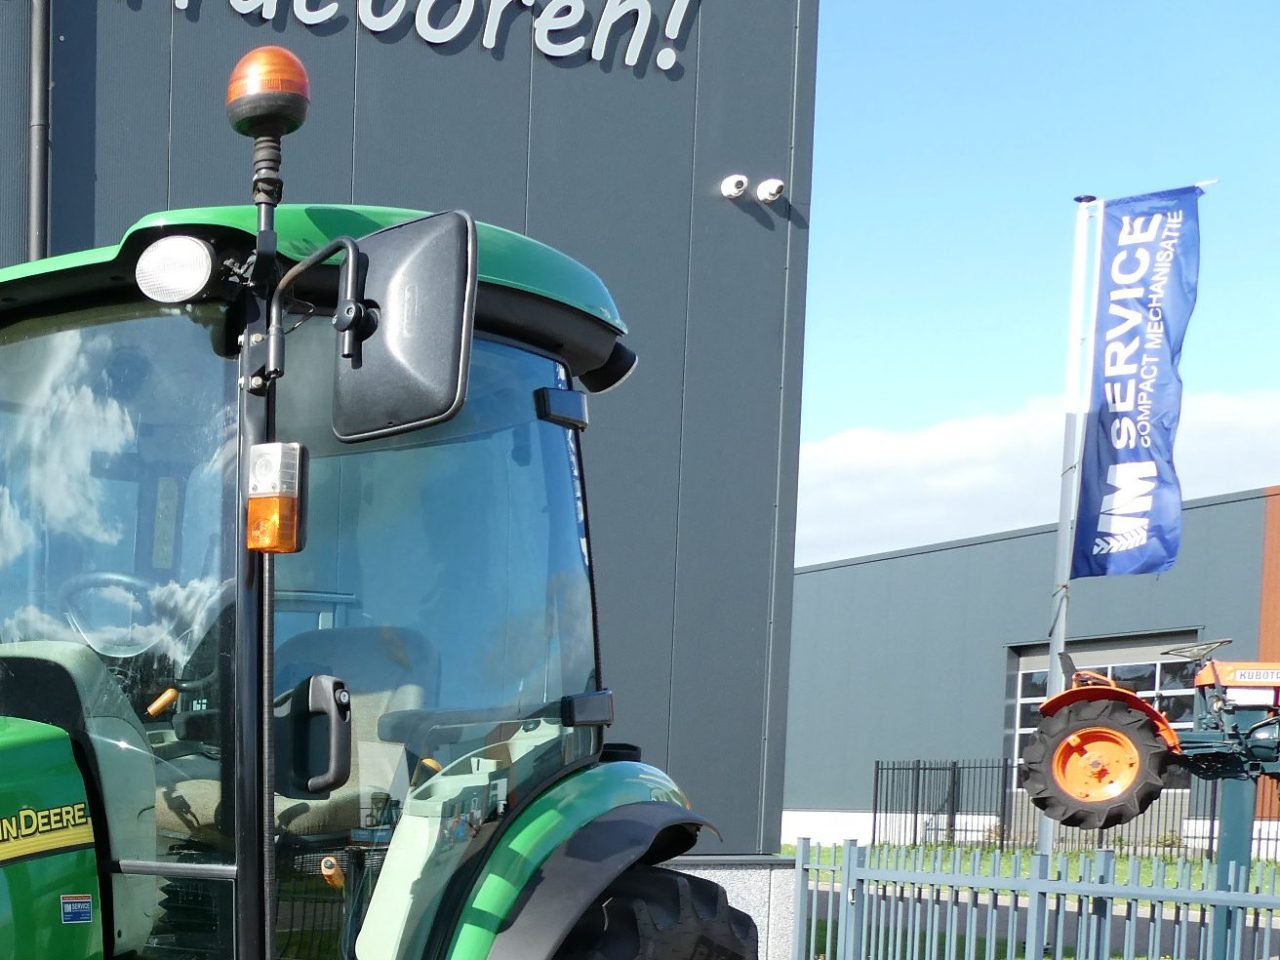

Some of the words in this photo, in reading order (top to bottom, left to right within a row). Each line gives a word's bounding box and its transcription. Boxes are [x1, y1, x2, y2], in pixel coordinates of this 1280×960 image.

[175, 0, 692, 71] oren!
[1145, 209, 1184, 348] MECHANISATIE
[1104, 212, 1163, 449] SERVICE
[1136, 354, 1162, 448] COMPACT
[18, 803, 88, 838] DEERE
